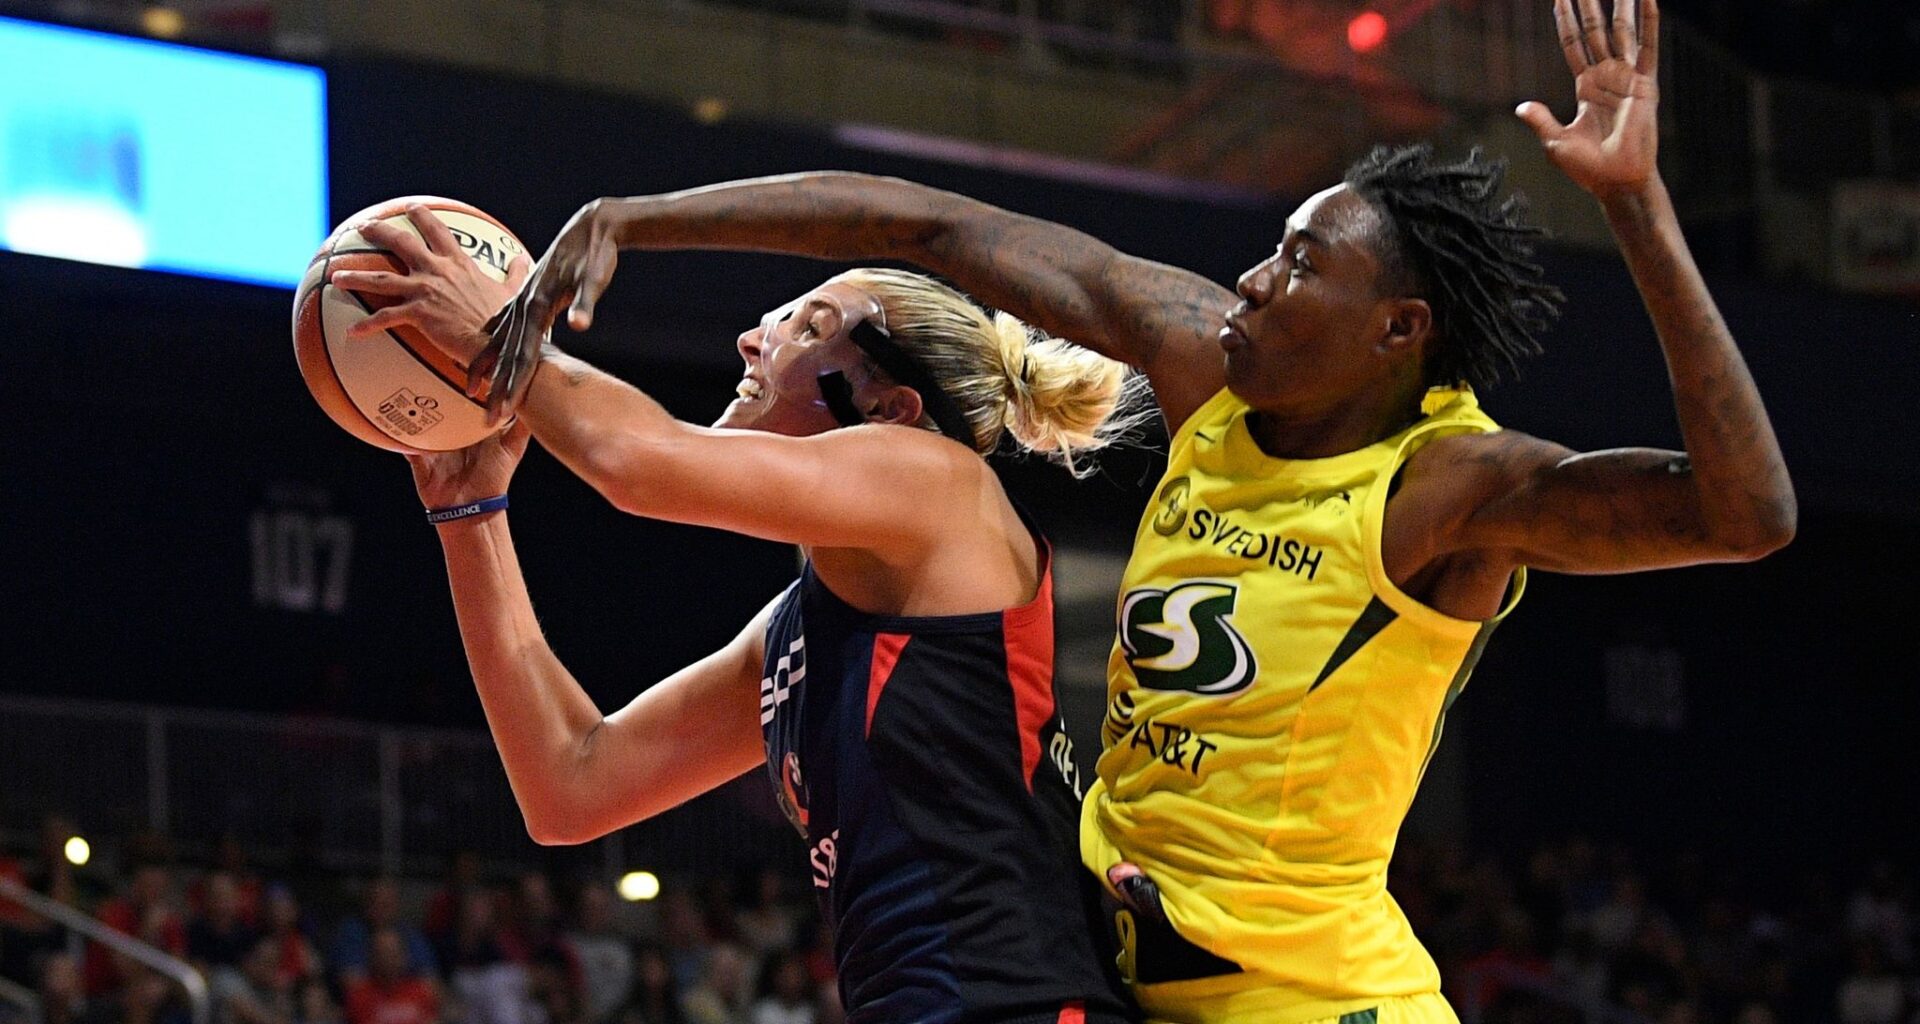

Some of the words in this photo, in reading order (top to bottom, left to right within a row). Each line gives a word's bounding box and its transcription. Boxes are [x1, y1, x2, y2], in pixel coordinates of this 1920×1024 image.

[250, 509, 353, 612] 107
[1189, 509, 1323, 581] SWEDISH
[1130, 718, 1217, 775] AT&T
